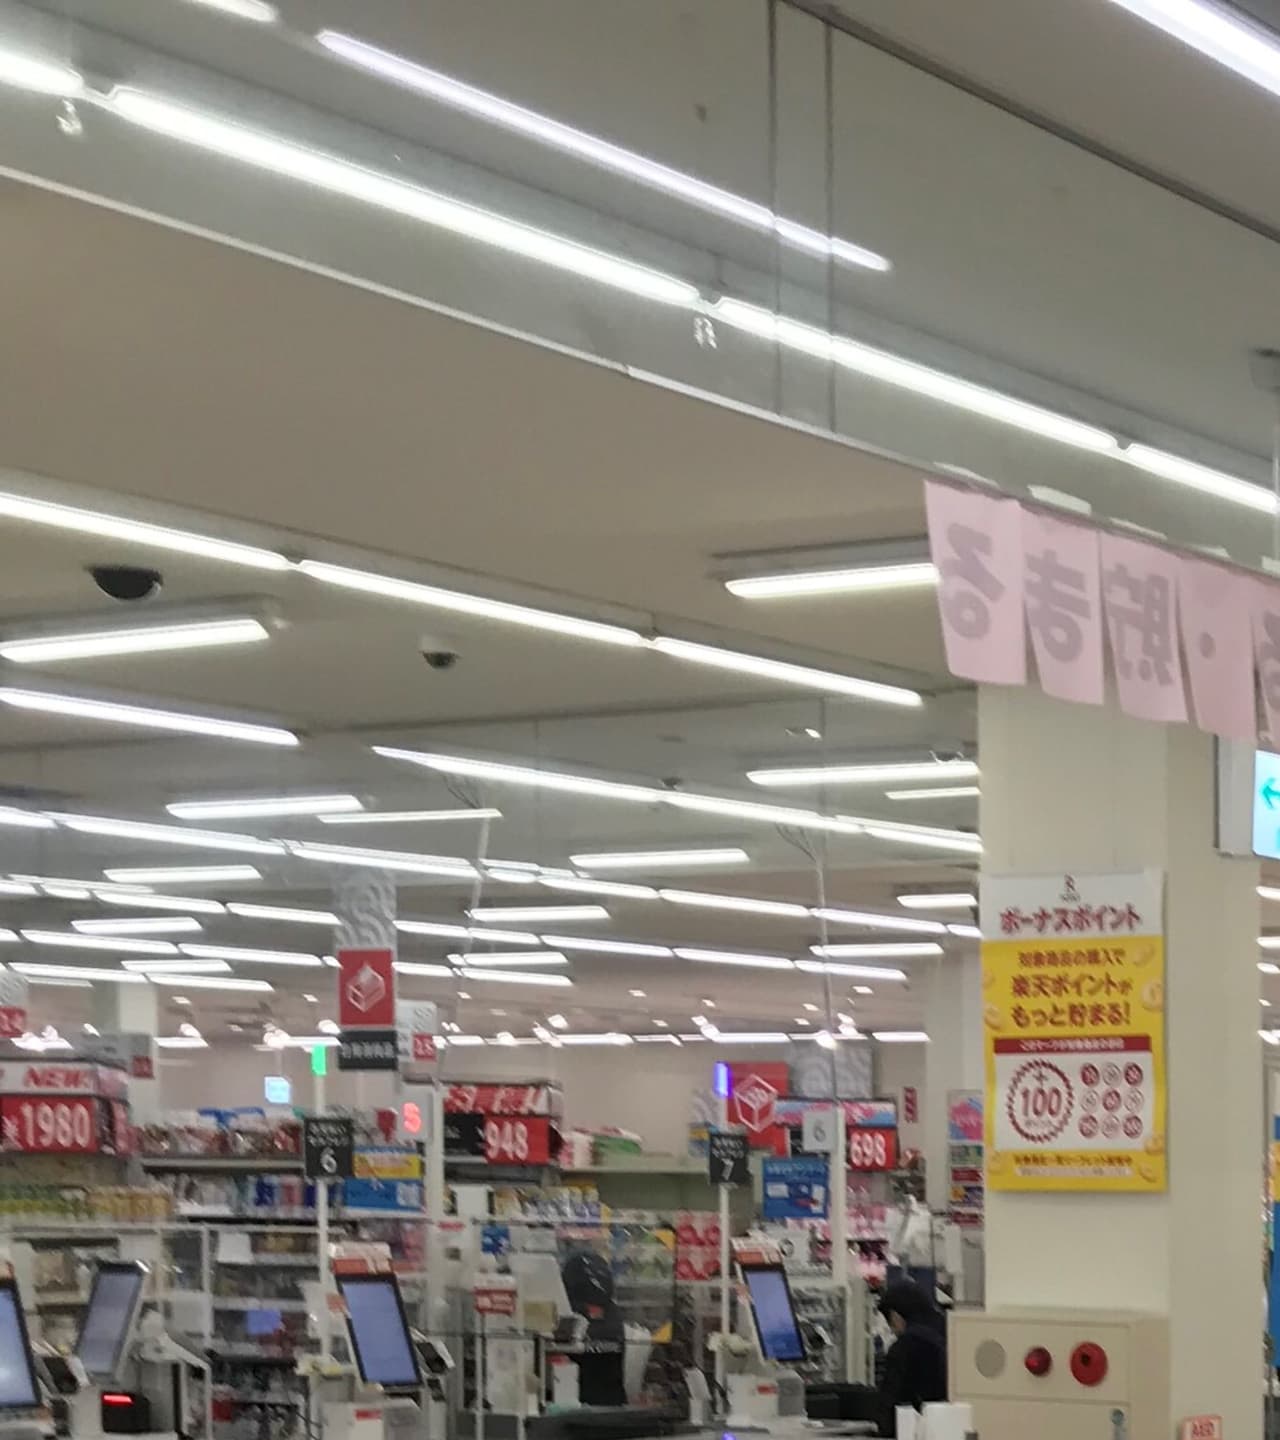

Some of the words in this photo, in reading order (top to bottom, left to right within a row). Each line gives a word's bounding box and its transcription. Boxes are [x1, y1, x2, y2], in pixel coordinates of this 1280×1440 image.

[999, 904, 1142, 934] ボーナスポイント
[1011, 972, 1133, 998] 楽天ポイントが
[1020, 1087, 1063, 1118] 100
[486, 1120, 528, 1161] 948
[851, 1132, 887, 1167] 698
[320, 1147, 338, 1174] 6
[721, 1158, 735, 1181] 7
